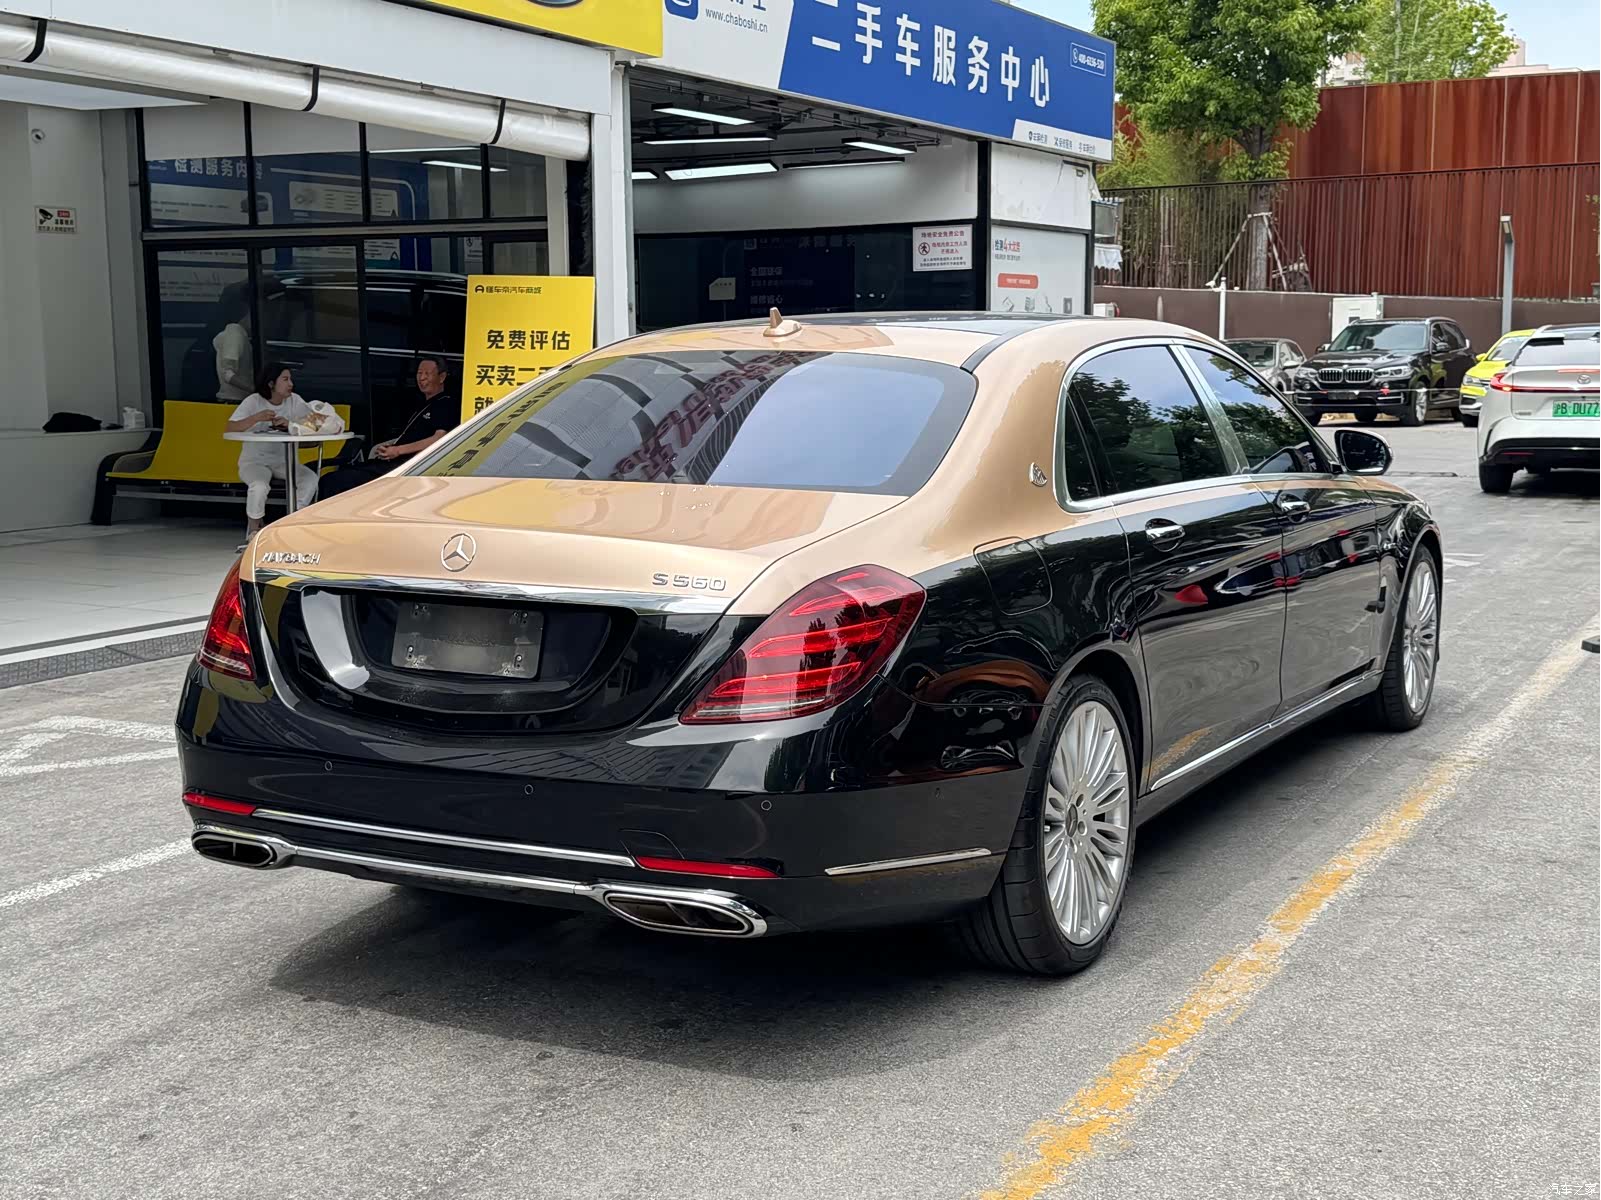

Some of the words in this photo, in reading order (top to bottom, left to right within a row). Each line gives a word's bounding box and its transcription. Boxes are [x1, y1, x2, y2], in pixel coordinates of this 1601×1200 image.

[705, 8, 768, 33] www.chaboshi.cn
[811, 0, 1050, 108] 二手车服务中心
[486, 329, 571, 350] 免费评估
[1573, 402, 1601, 415] DU77
[652, 572, 669, 586] S
[672, 574, 727, 591] 560
